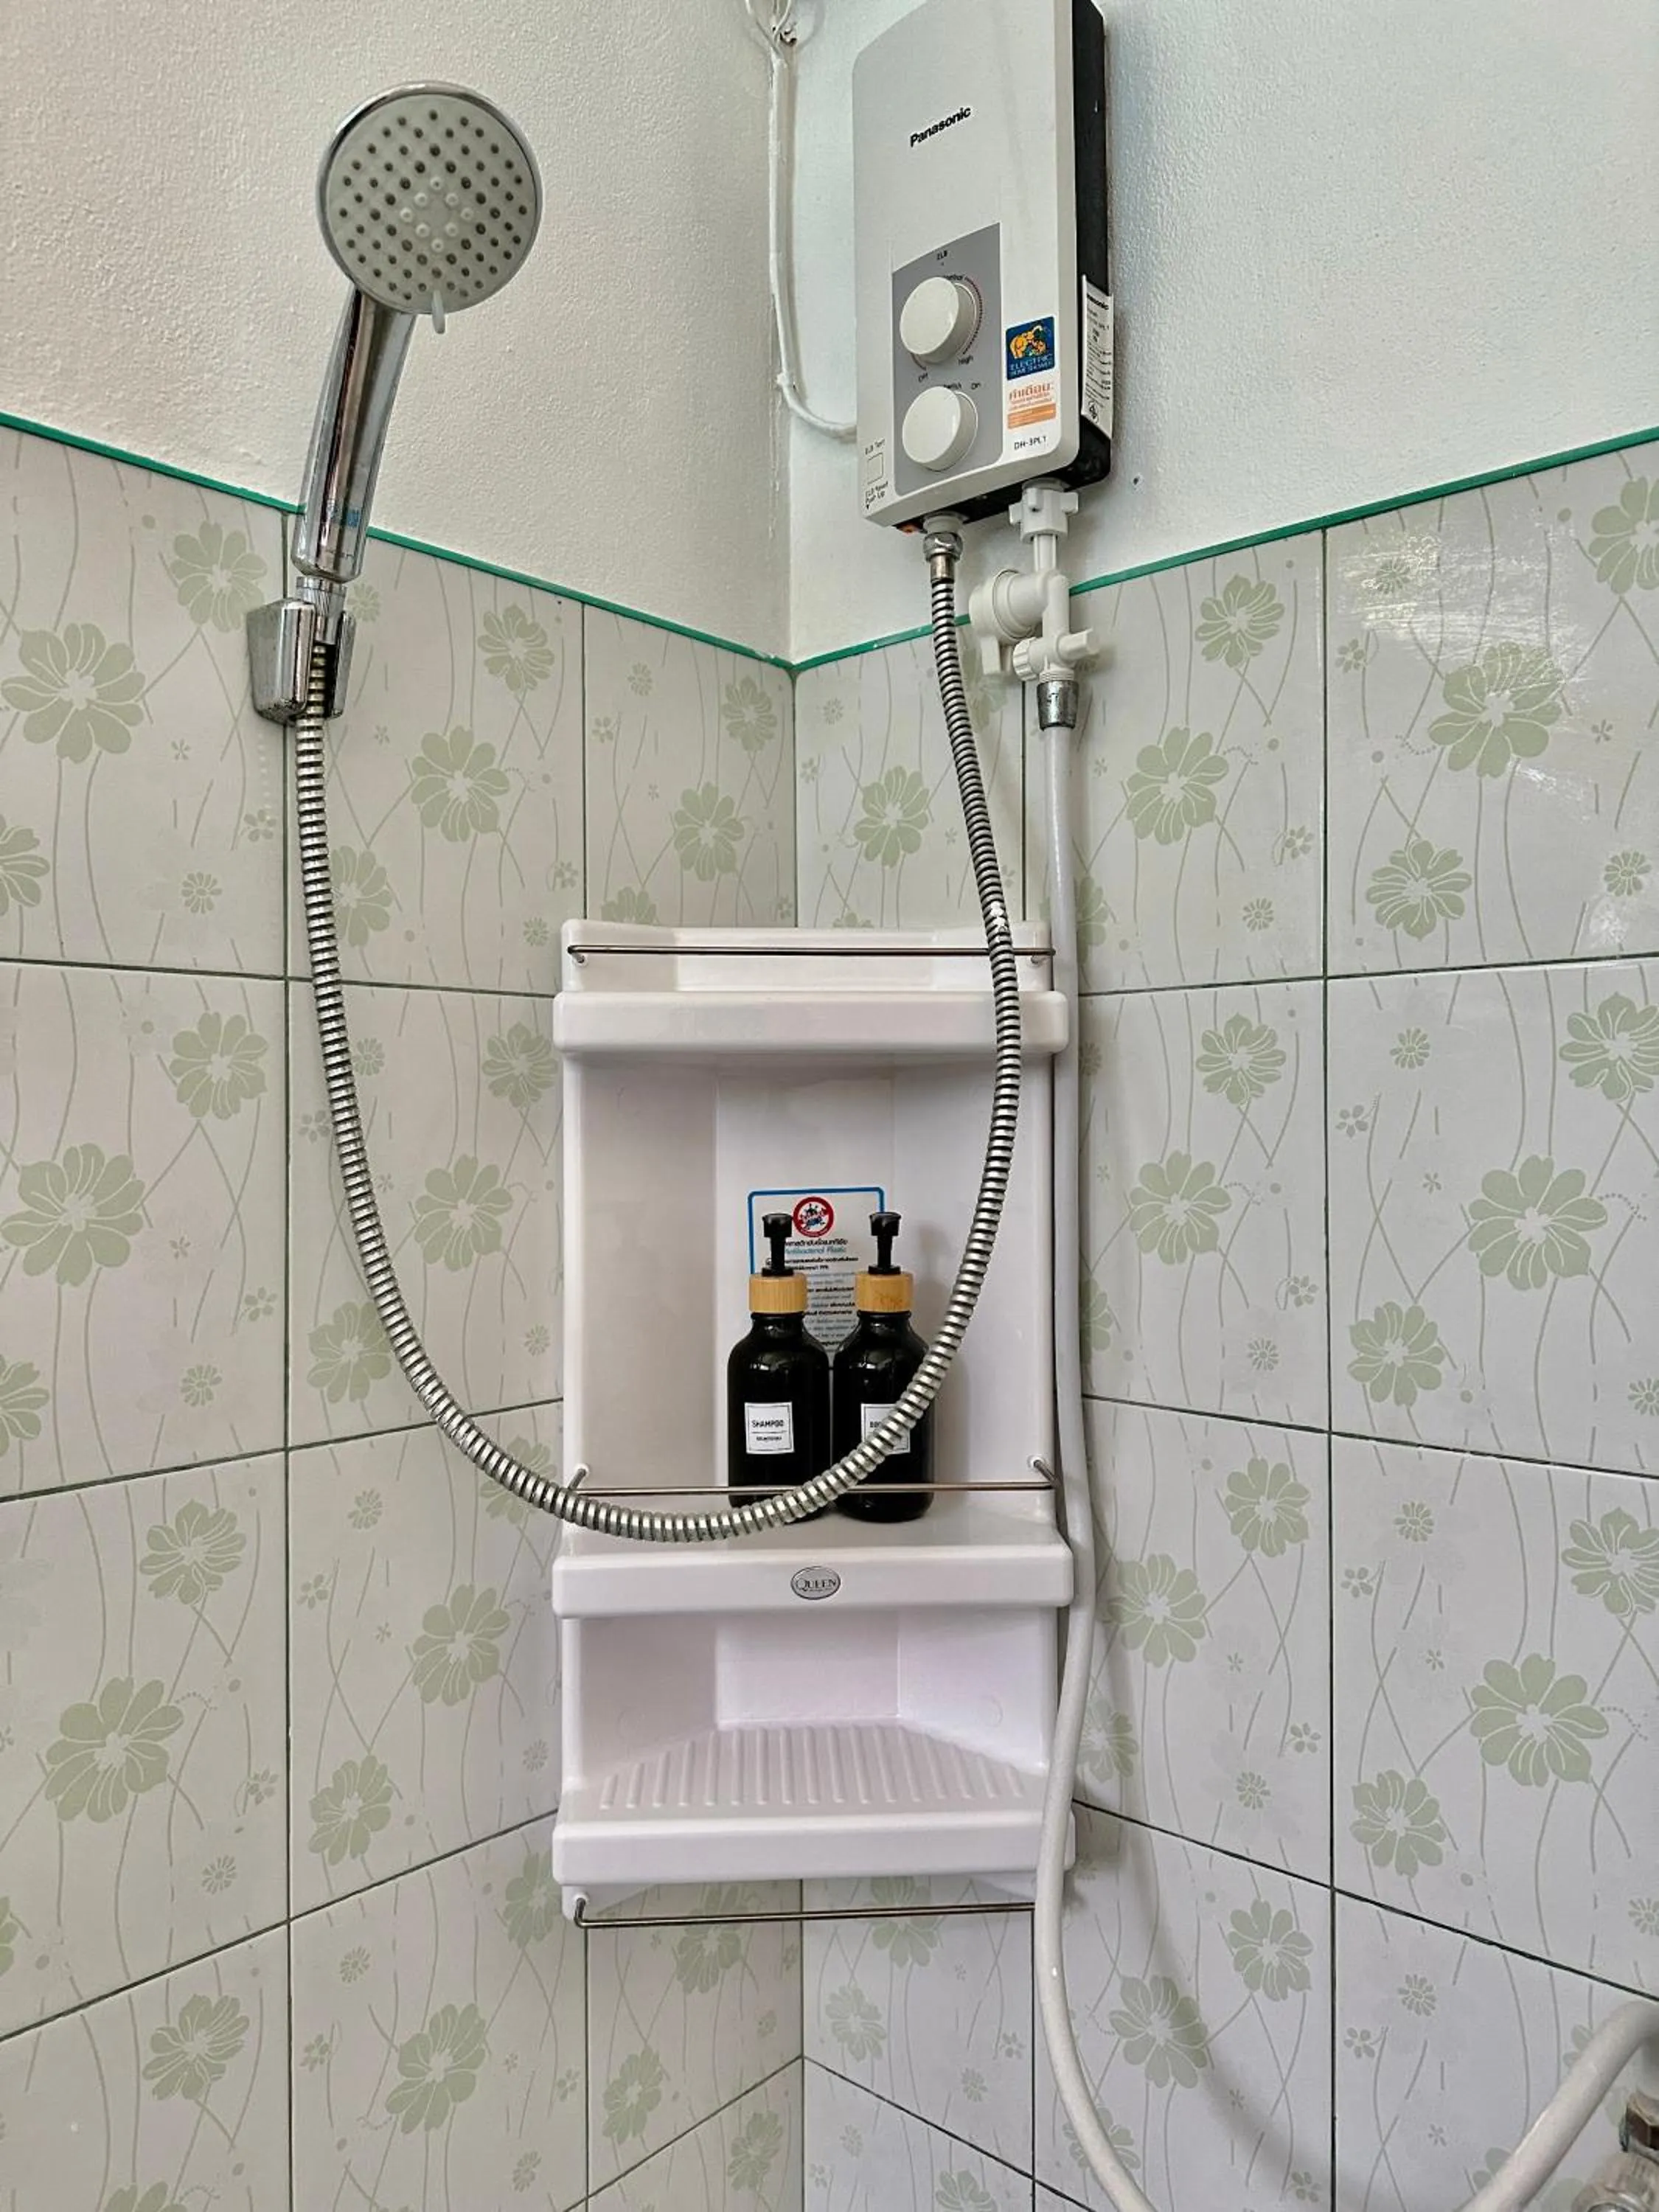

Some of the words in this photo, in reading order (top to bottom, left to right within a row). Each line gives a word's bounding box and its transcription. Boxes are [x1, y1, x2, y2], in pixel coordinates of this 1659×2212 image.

[910, 106, 971, 148] Panasonic
[751, 1419, 784, 1428] SHAMPOO
[796, 1578, 836, 1592] QUEEN
